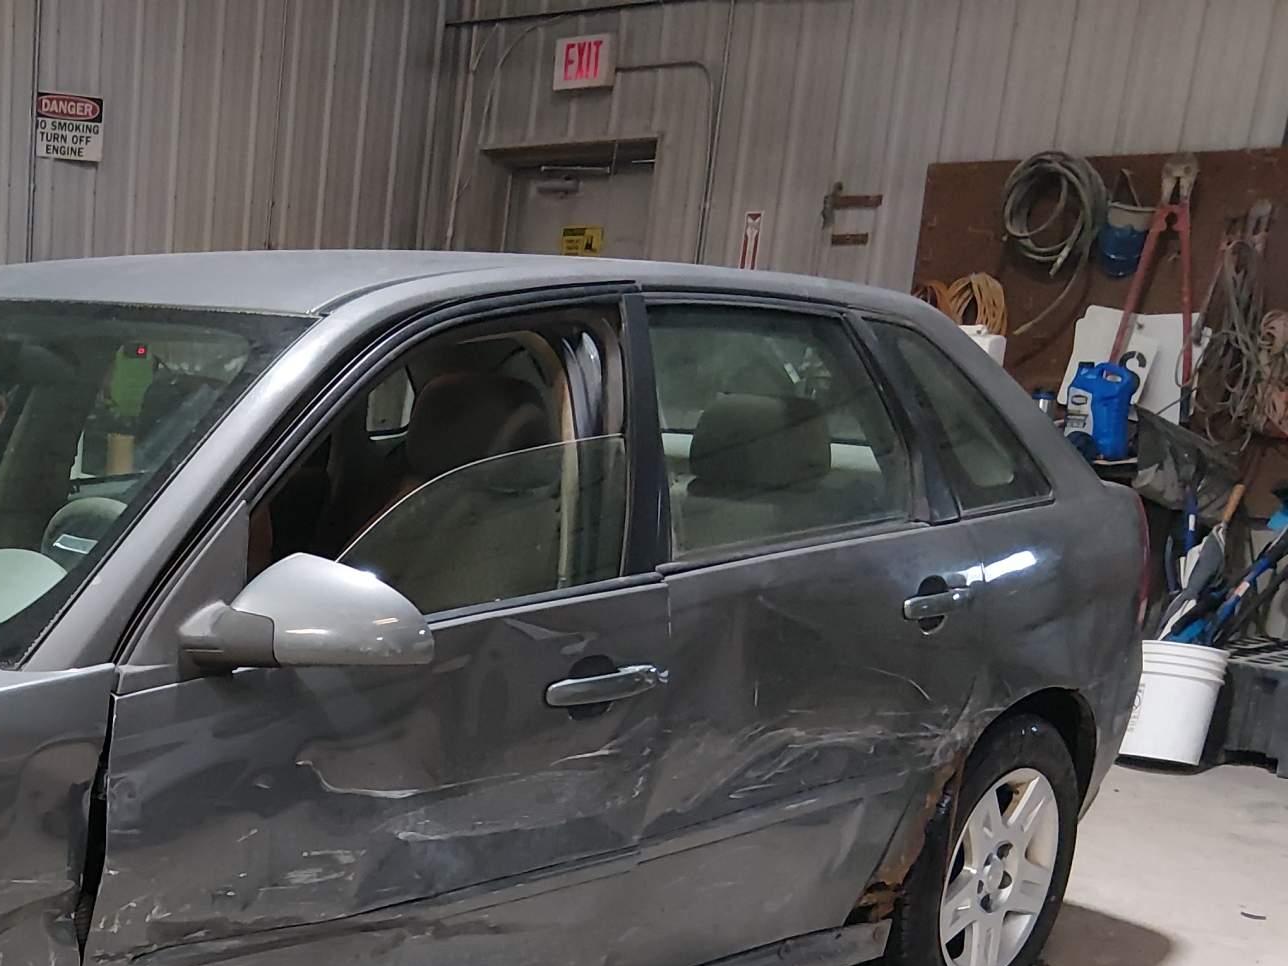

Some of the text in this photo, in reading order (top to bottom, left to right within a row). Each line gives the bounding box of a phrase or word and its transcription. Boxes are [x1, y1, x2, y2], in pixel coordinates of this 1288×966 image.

[563, 40, 603, 81] EXIT
[41, 99, 93, 117] DANGER
[36, 119, 100, 136] O SMOKING
[40, 131, 92, 146] TURN OFF
[46, 144, 85, 158] ENGINE
